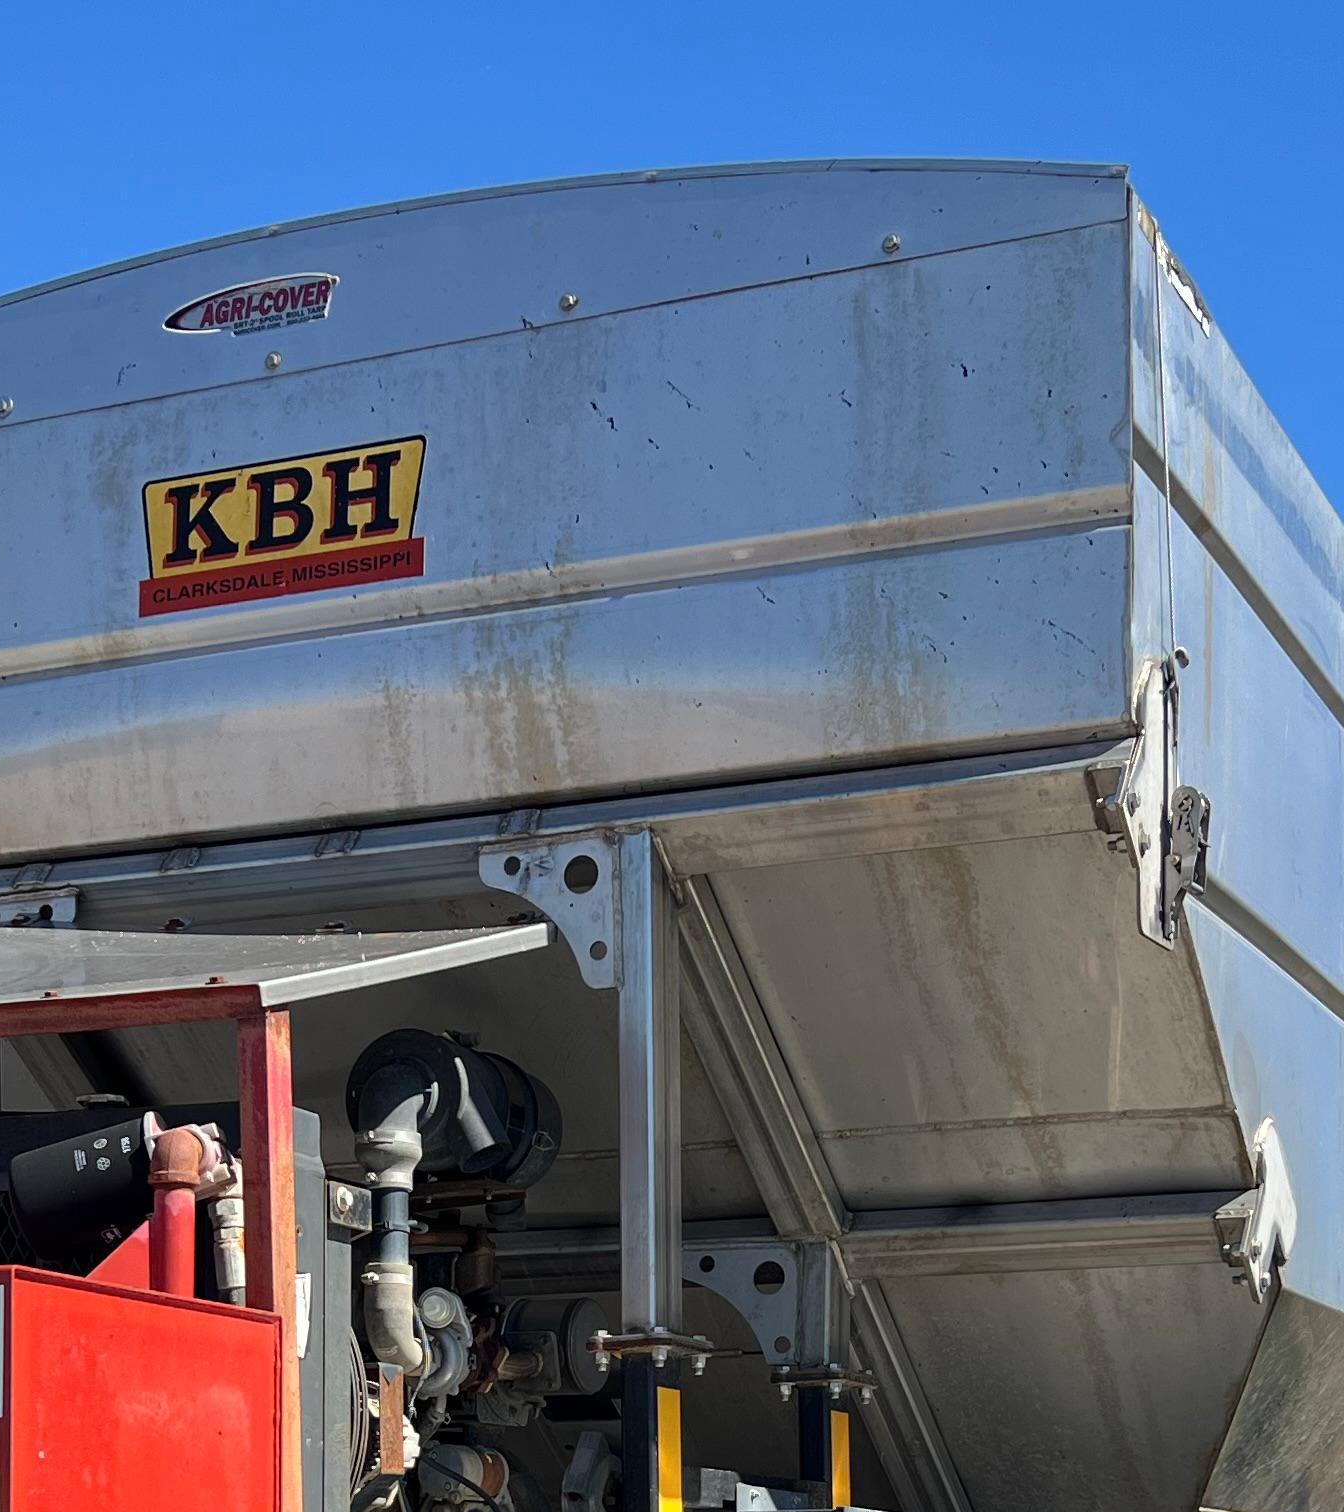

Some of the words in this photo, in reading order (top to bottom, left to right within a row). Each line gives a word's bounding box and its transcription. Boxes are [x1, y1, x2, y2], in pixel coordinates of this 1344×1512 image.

[200, 279, 331, 328] AGRI-COVER
[286, 310, 305, 319] ROLL
[163, 449, 402, 569] KBH
[292, 551, 412, 583] MISSISSIPPI
